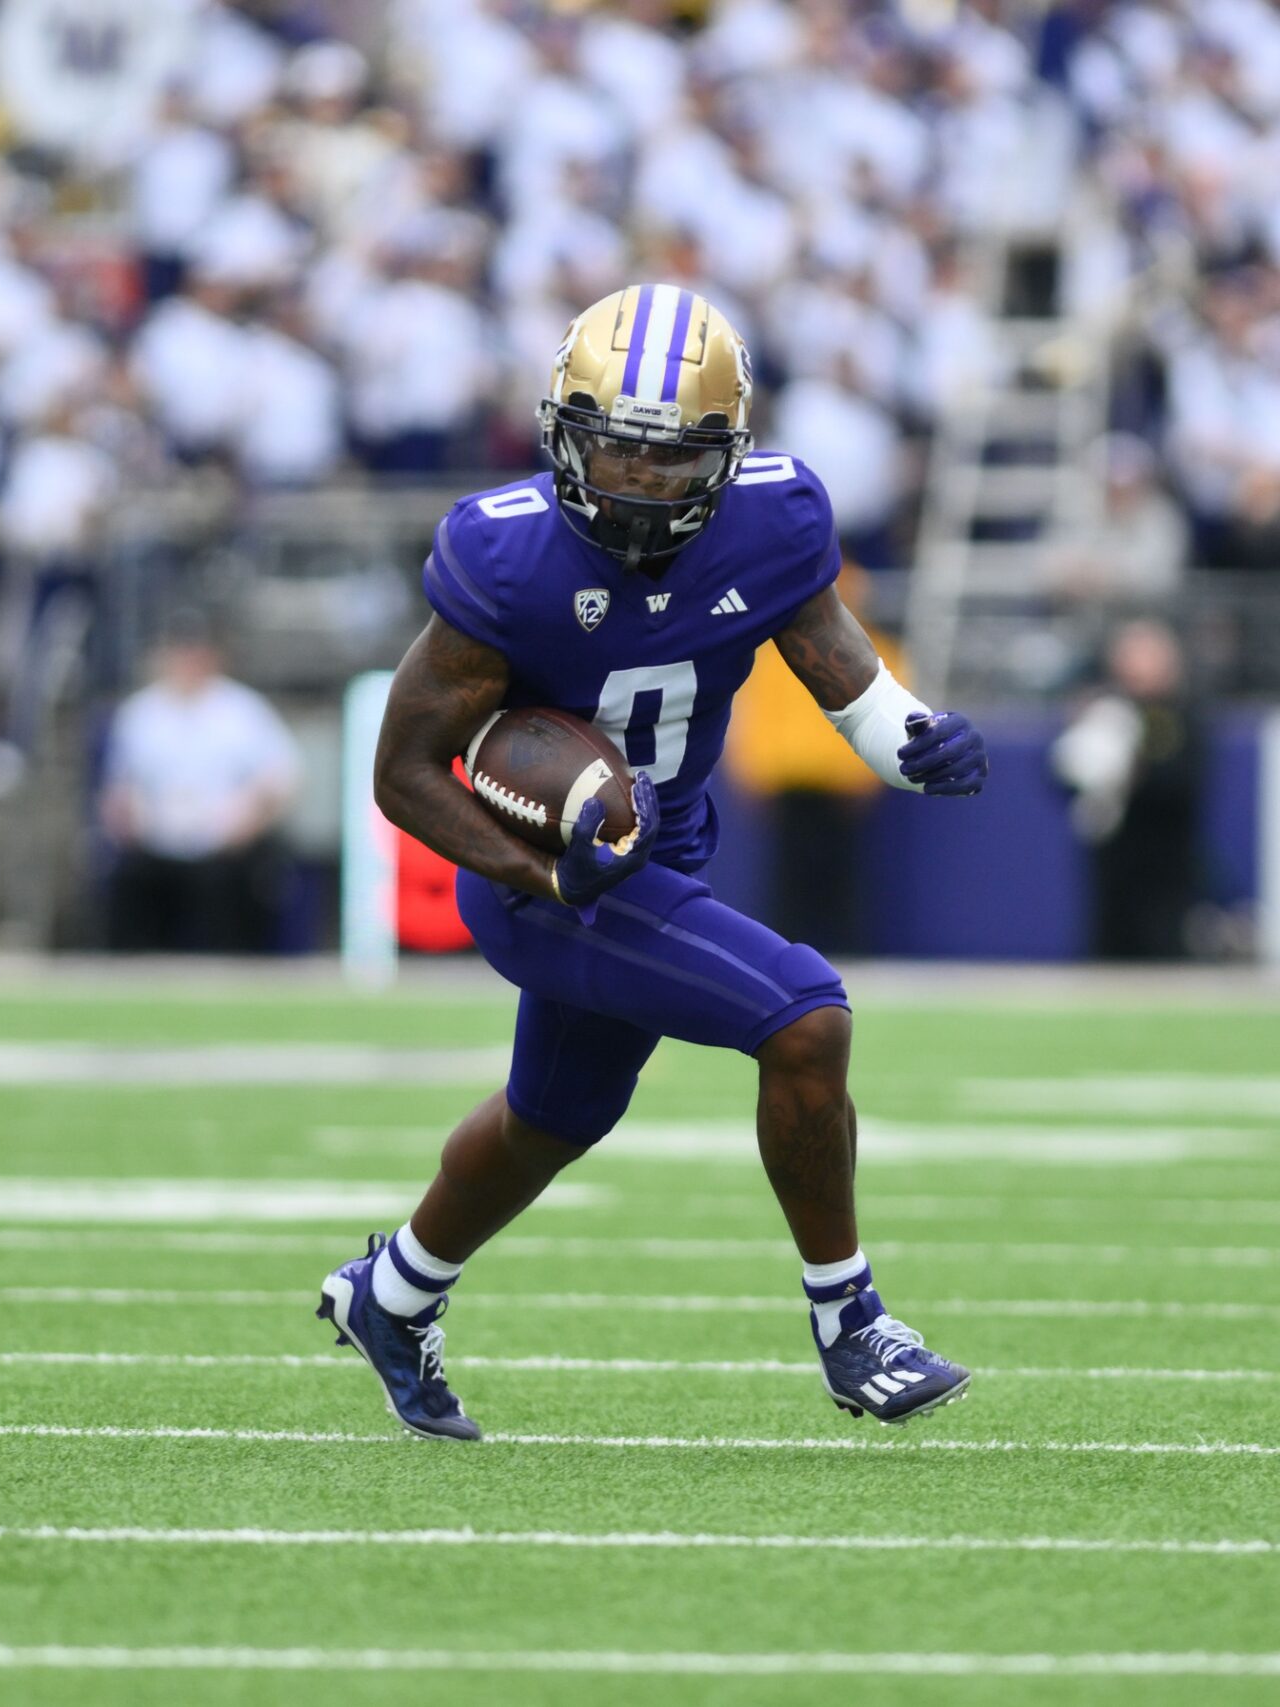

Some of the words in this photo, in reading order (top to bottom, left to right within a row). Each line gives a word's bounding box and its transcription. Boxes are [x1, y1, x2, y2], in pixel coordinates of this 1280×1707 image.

[633, 406, 662, 416] DAWGS
[477, 487, 550, 519] 0
[577, 591, 608, 614] PAC
[646, 593, 671, 613] W
[582, 607, 600, 623] 12
[592, 660, 698, 785] 0
